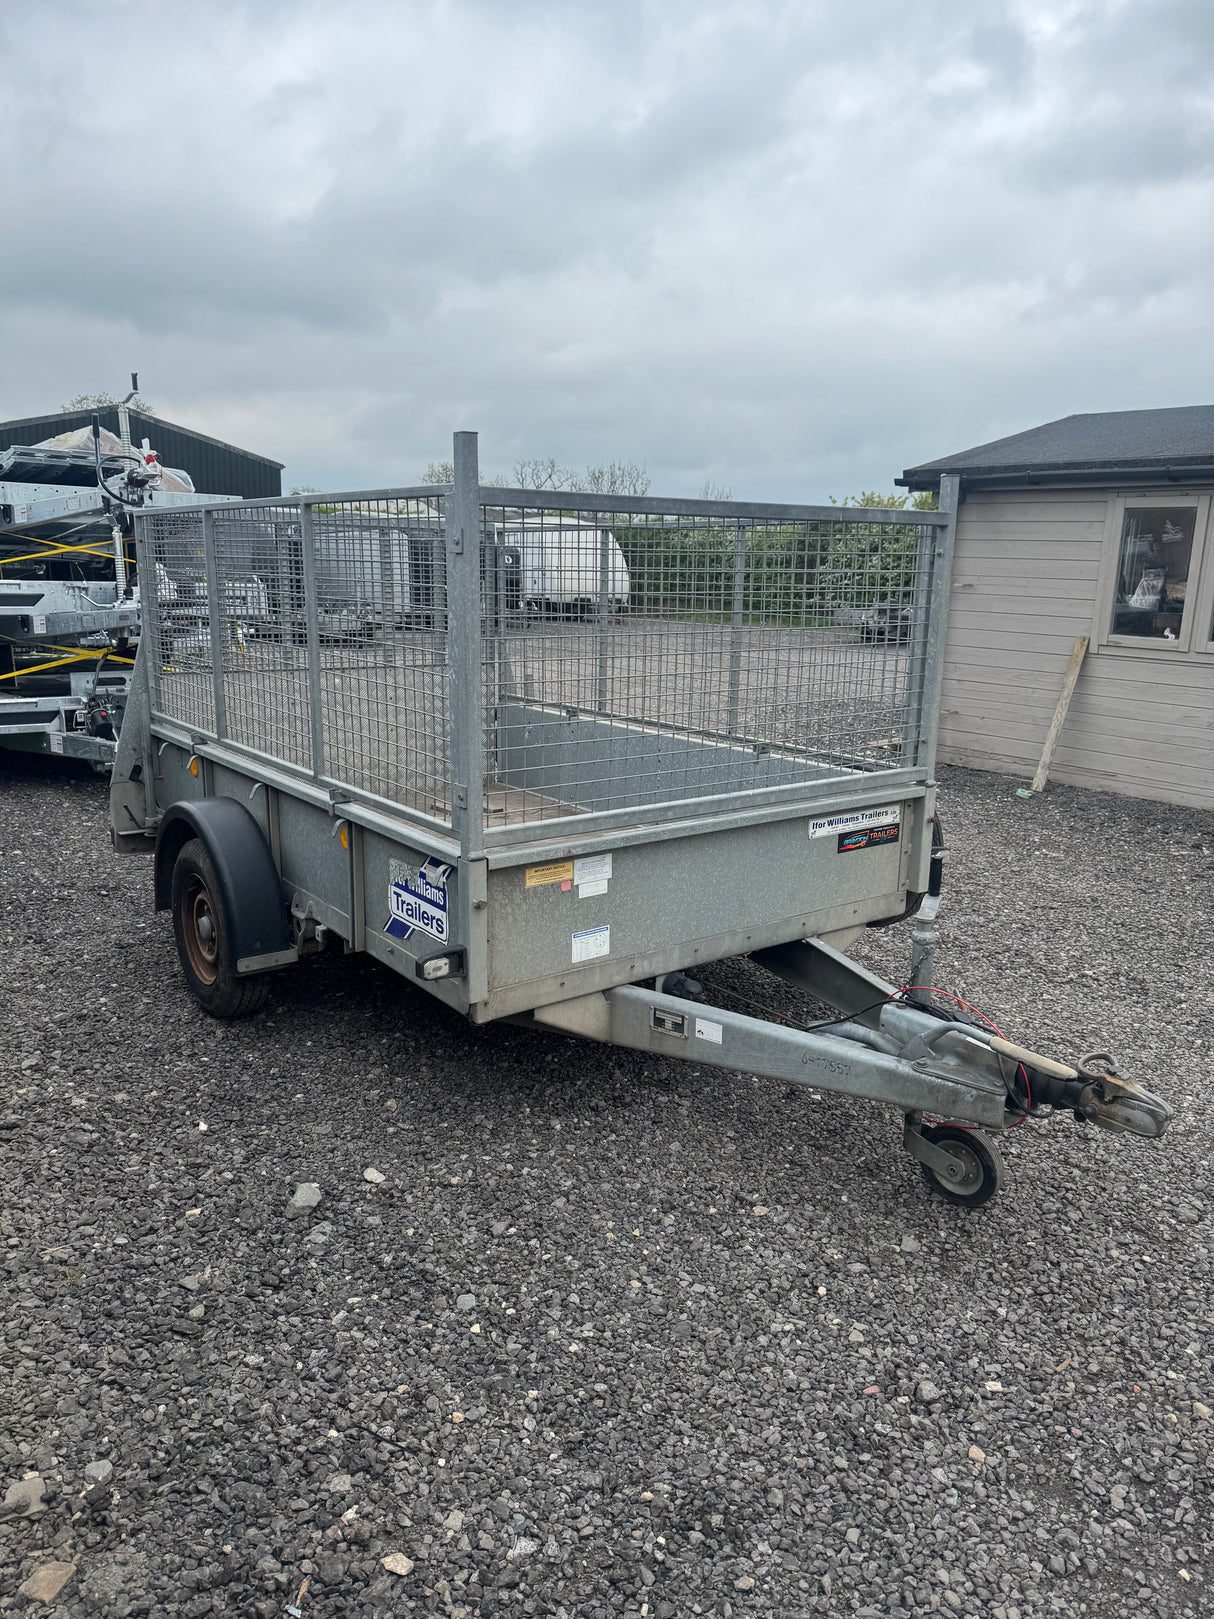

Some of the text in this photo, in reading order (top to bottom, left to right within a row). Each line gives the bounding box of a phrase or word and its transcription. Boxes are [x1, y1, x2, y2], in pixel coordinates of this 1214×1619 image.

[812, 822, 826, 830] Ifor
[827, 815, 859, 826] Williams
[860, 810, 889, 821] Trailers
[869, 828, 898, 839] TRAILERS
[393, 890, 445, 935] Trailers
